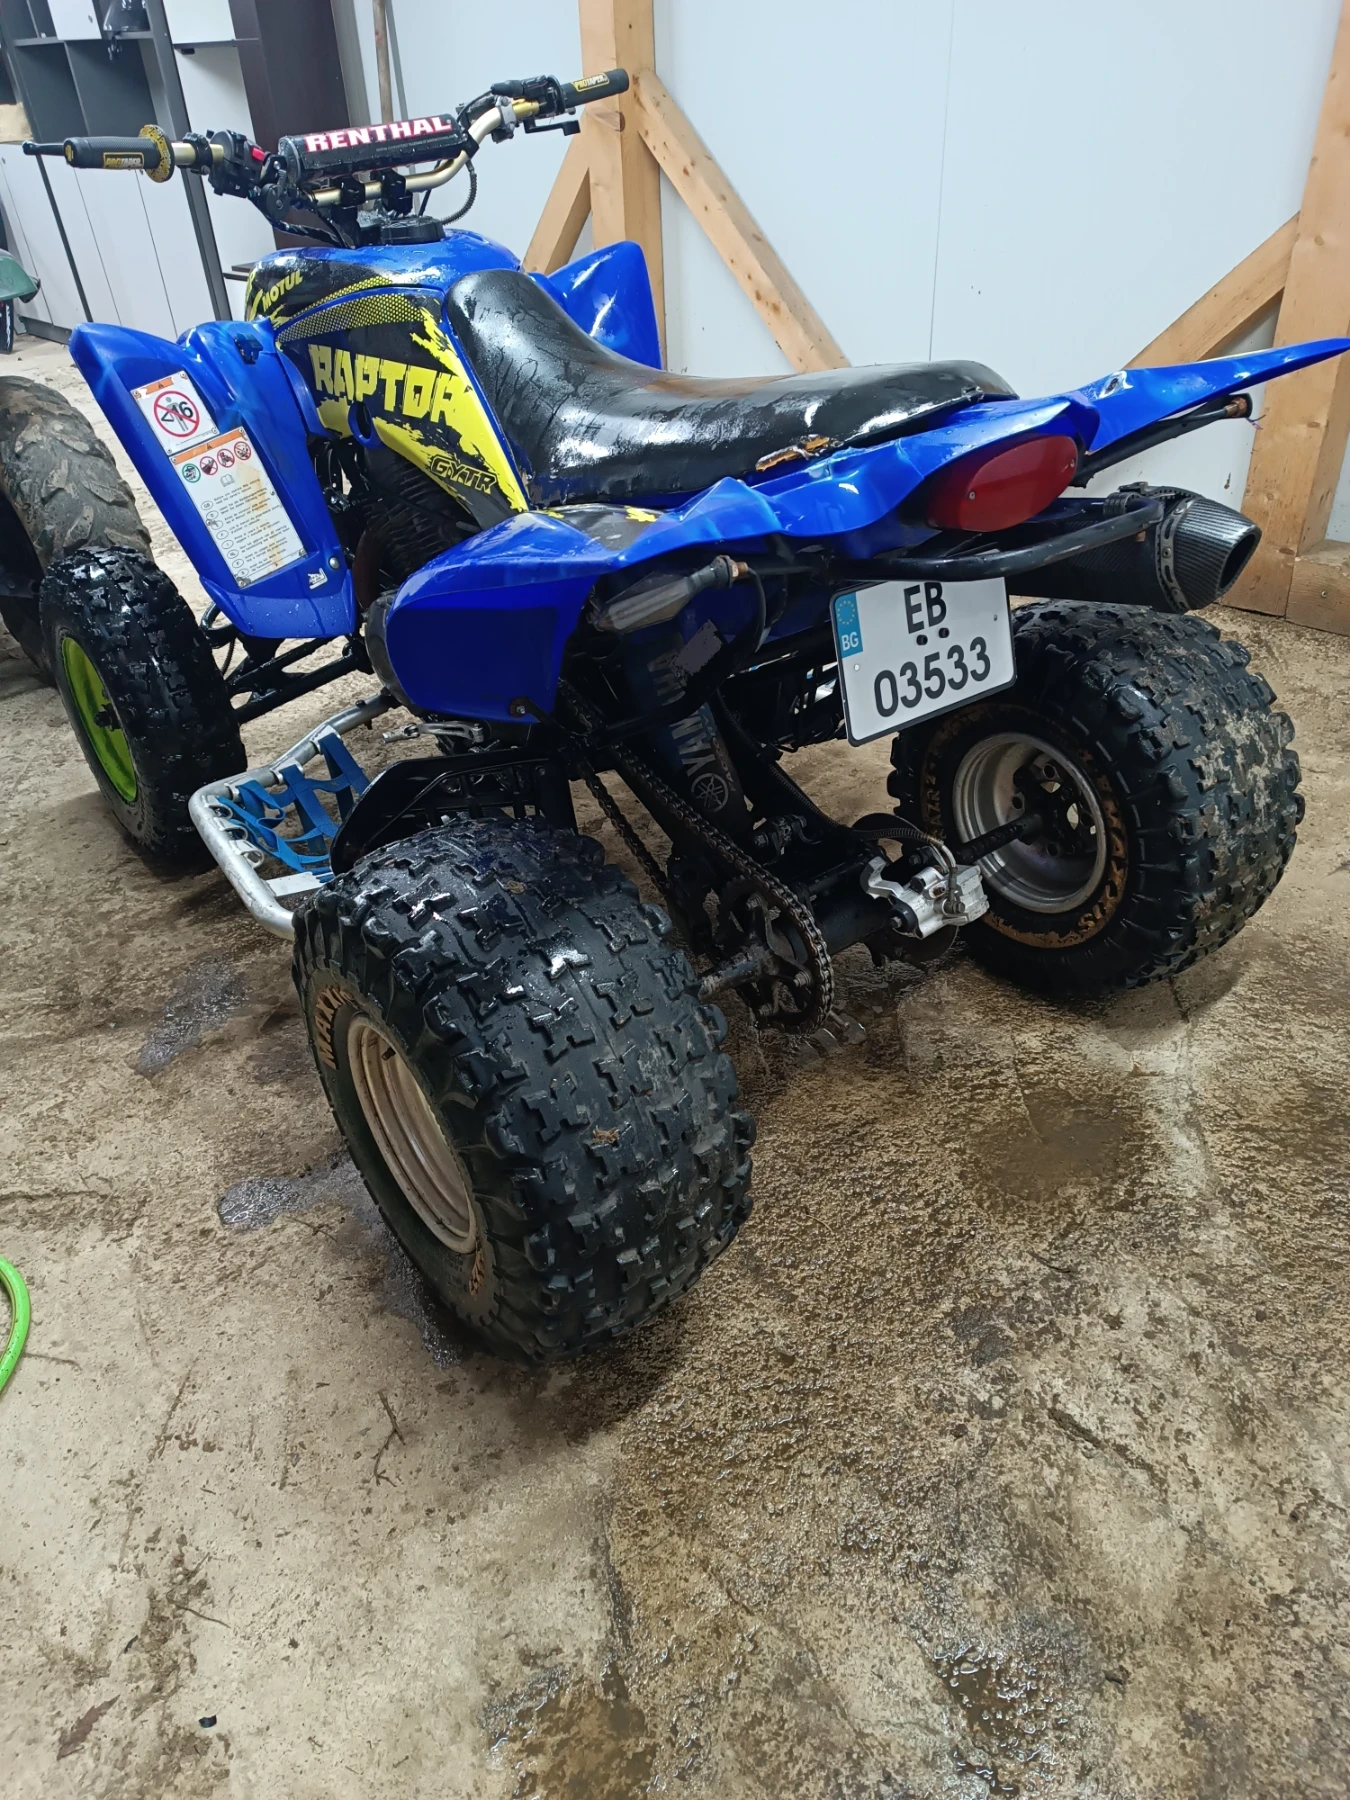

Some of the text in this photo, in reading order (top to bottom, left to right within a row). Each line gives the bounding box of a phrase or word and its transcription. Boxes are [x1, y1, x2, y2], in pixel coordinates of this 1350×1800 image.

[304, 115, 451, 152] RENTHAL
[262, 271, 303, 312] MOTUL
[308, 344, 470, 426] RAPTOR
[431, 454, 497, 494] GYTR
[903, 582, 947, 634] EB
[841, 632, 859, 651] BG
[874, 636, 991, 718] 03533
